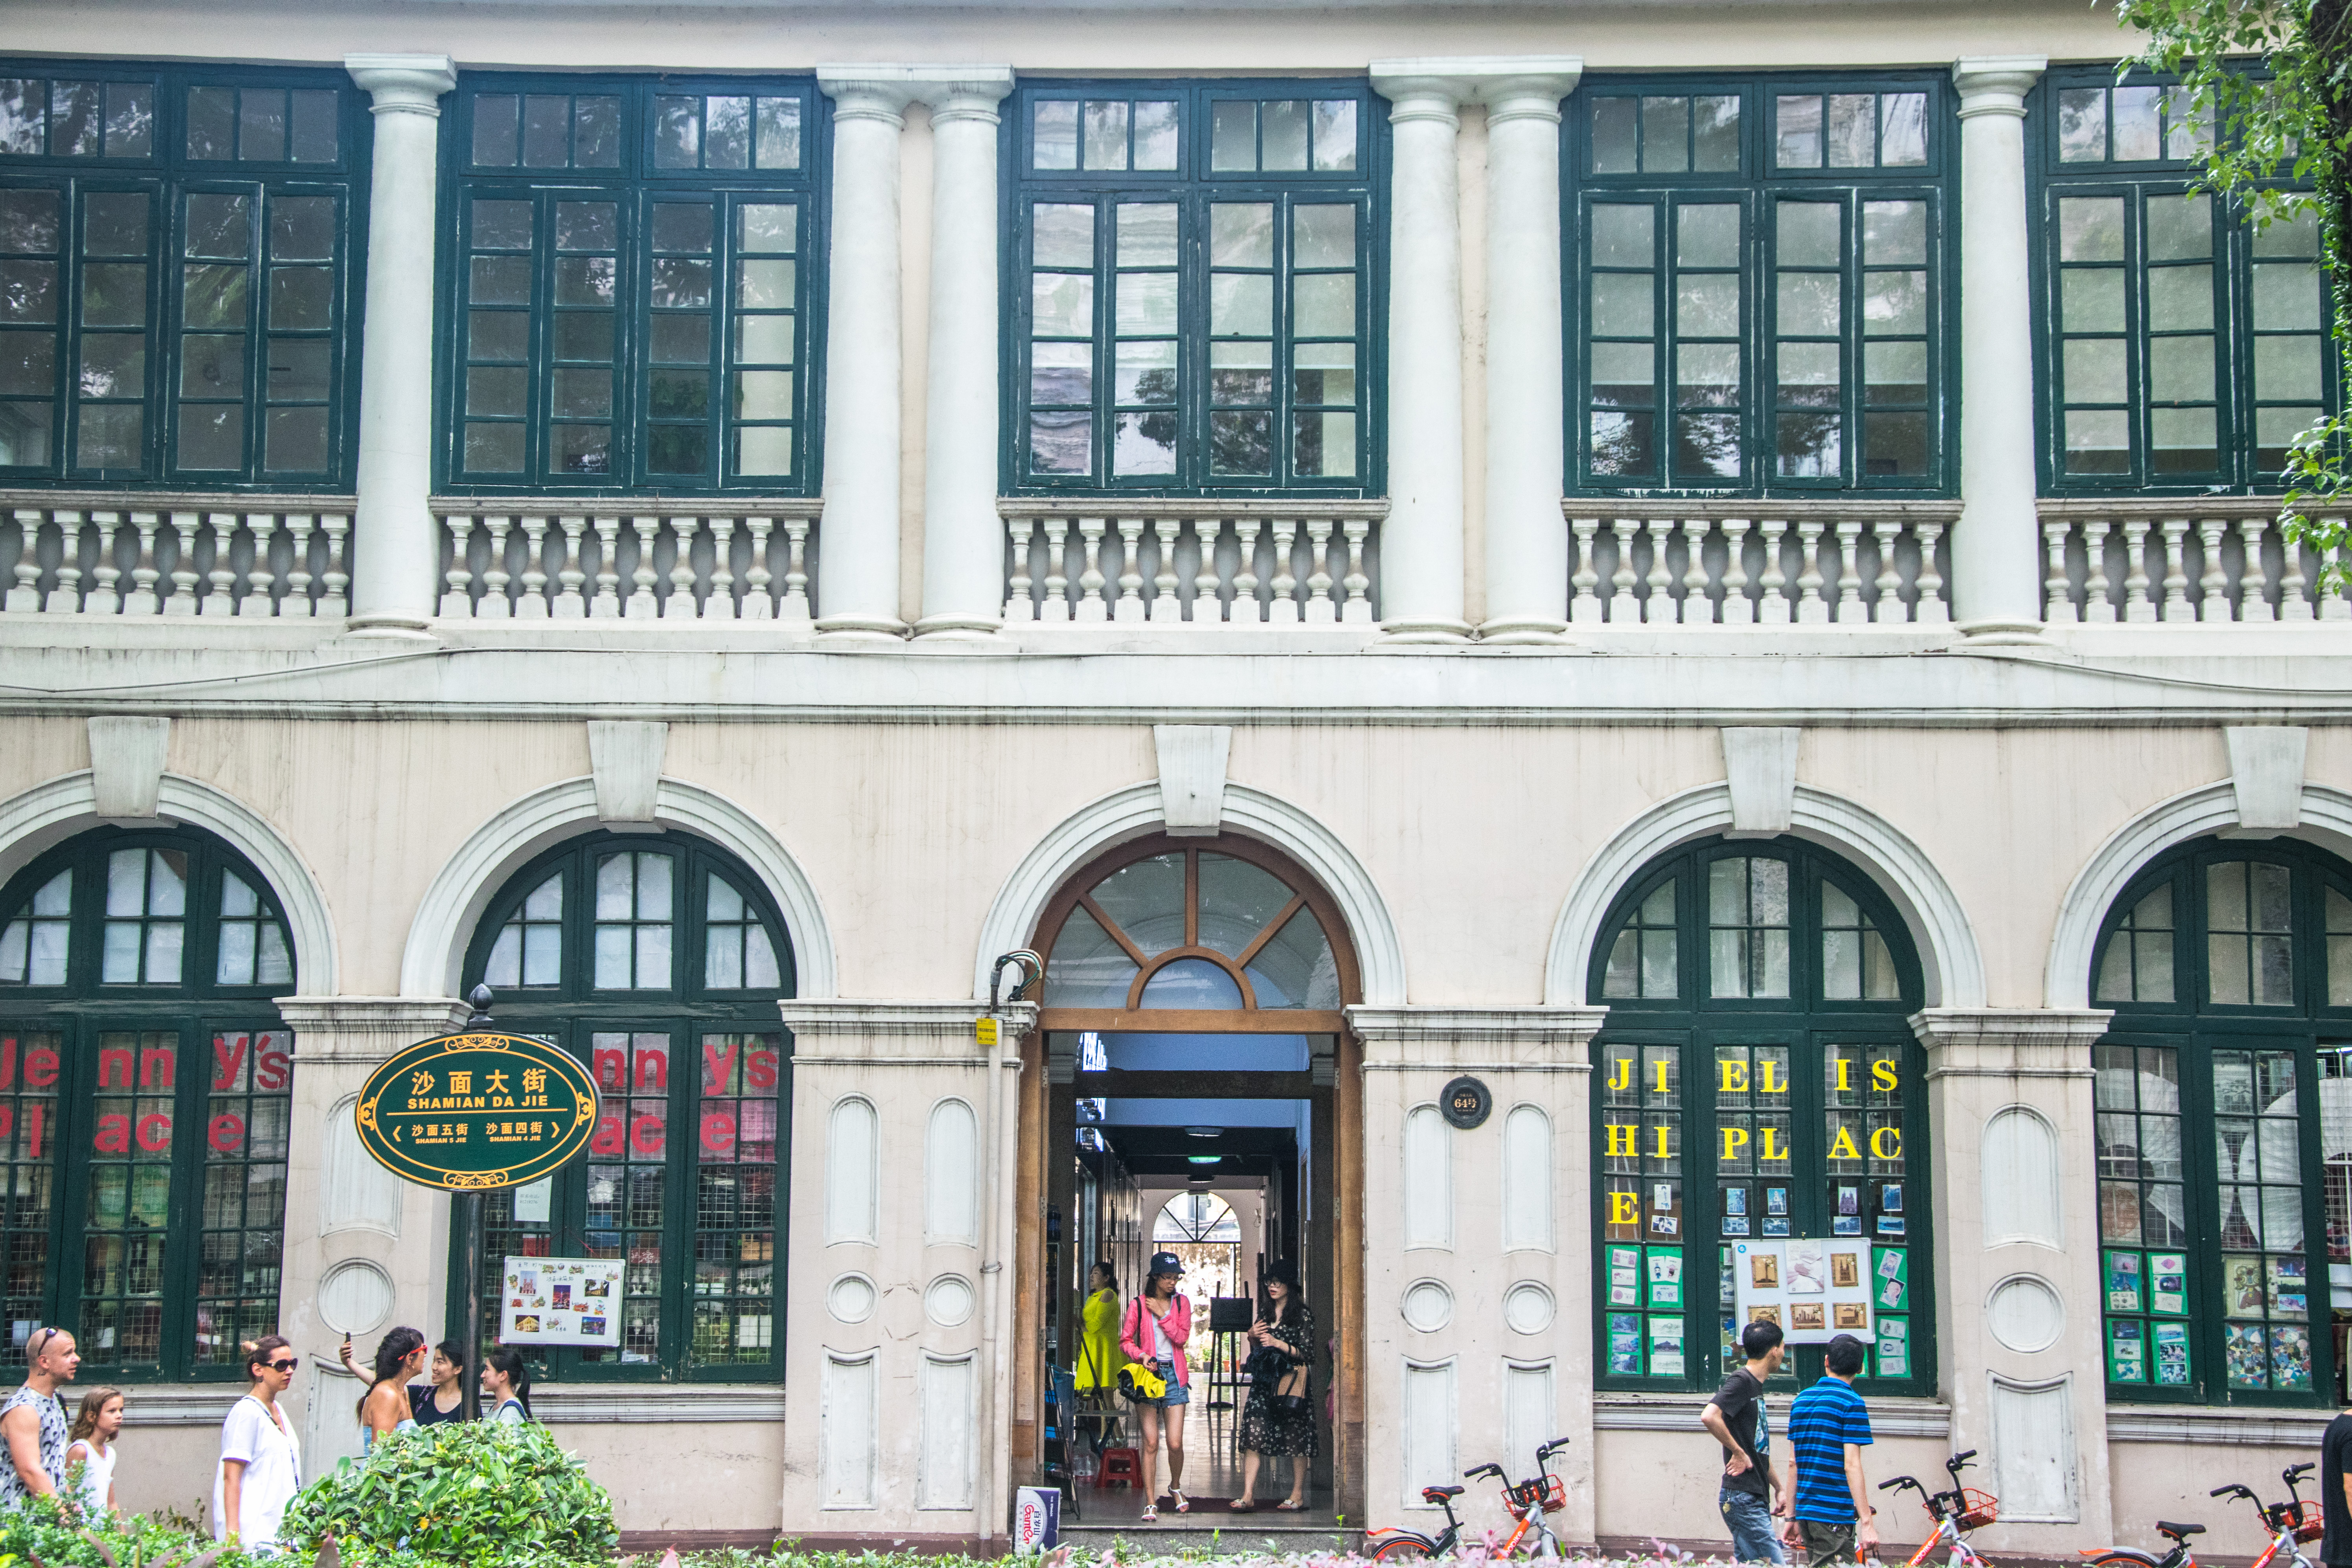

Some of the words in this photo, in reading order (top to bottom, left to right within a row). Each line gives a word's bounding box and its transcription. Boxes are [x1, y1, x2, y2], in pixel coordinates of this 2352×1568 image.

[594, 1042, 777, 1096] nny's
[411, 1068, 547, 1095] 沙面大街
[408, 1097, 485, 1109] SHAMIAN
[493, 1096, 514, 1107] DA
[521, 1095, 548, 1107] JIE
[1454, 1098, 1477, 1108] 64号
[412, 1123, 468, 1136] 沙面五街
[486, 1121, 542, 1134] 沙面四街
[591, 1113, 736, 1154] ace
[1608, 1192, 1638, 1225] E
